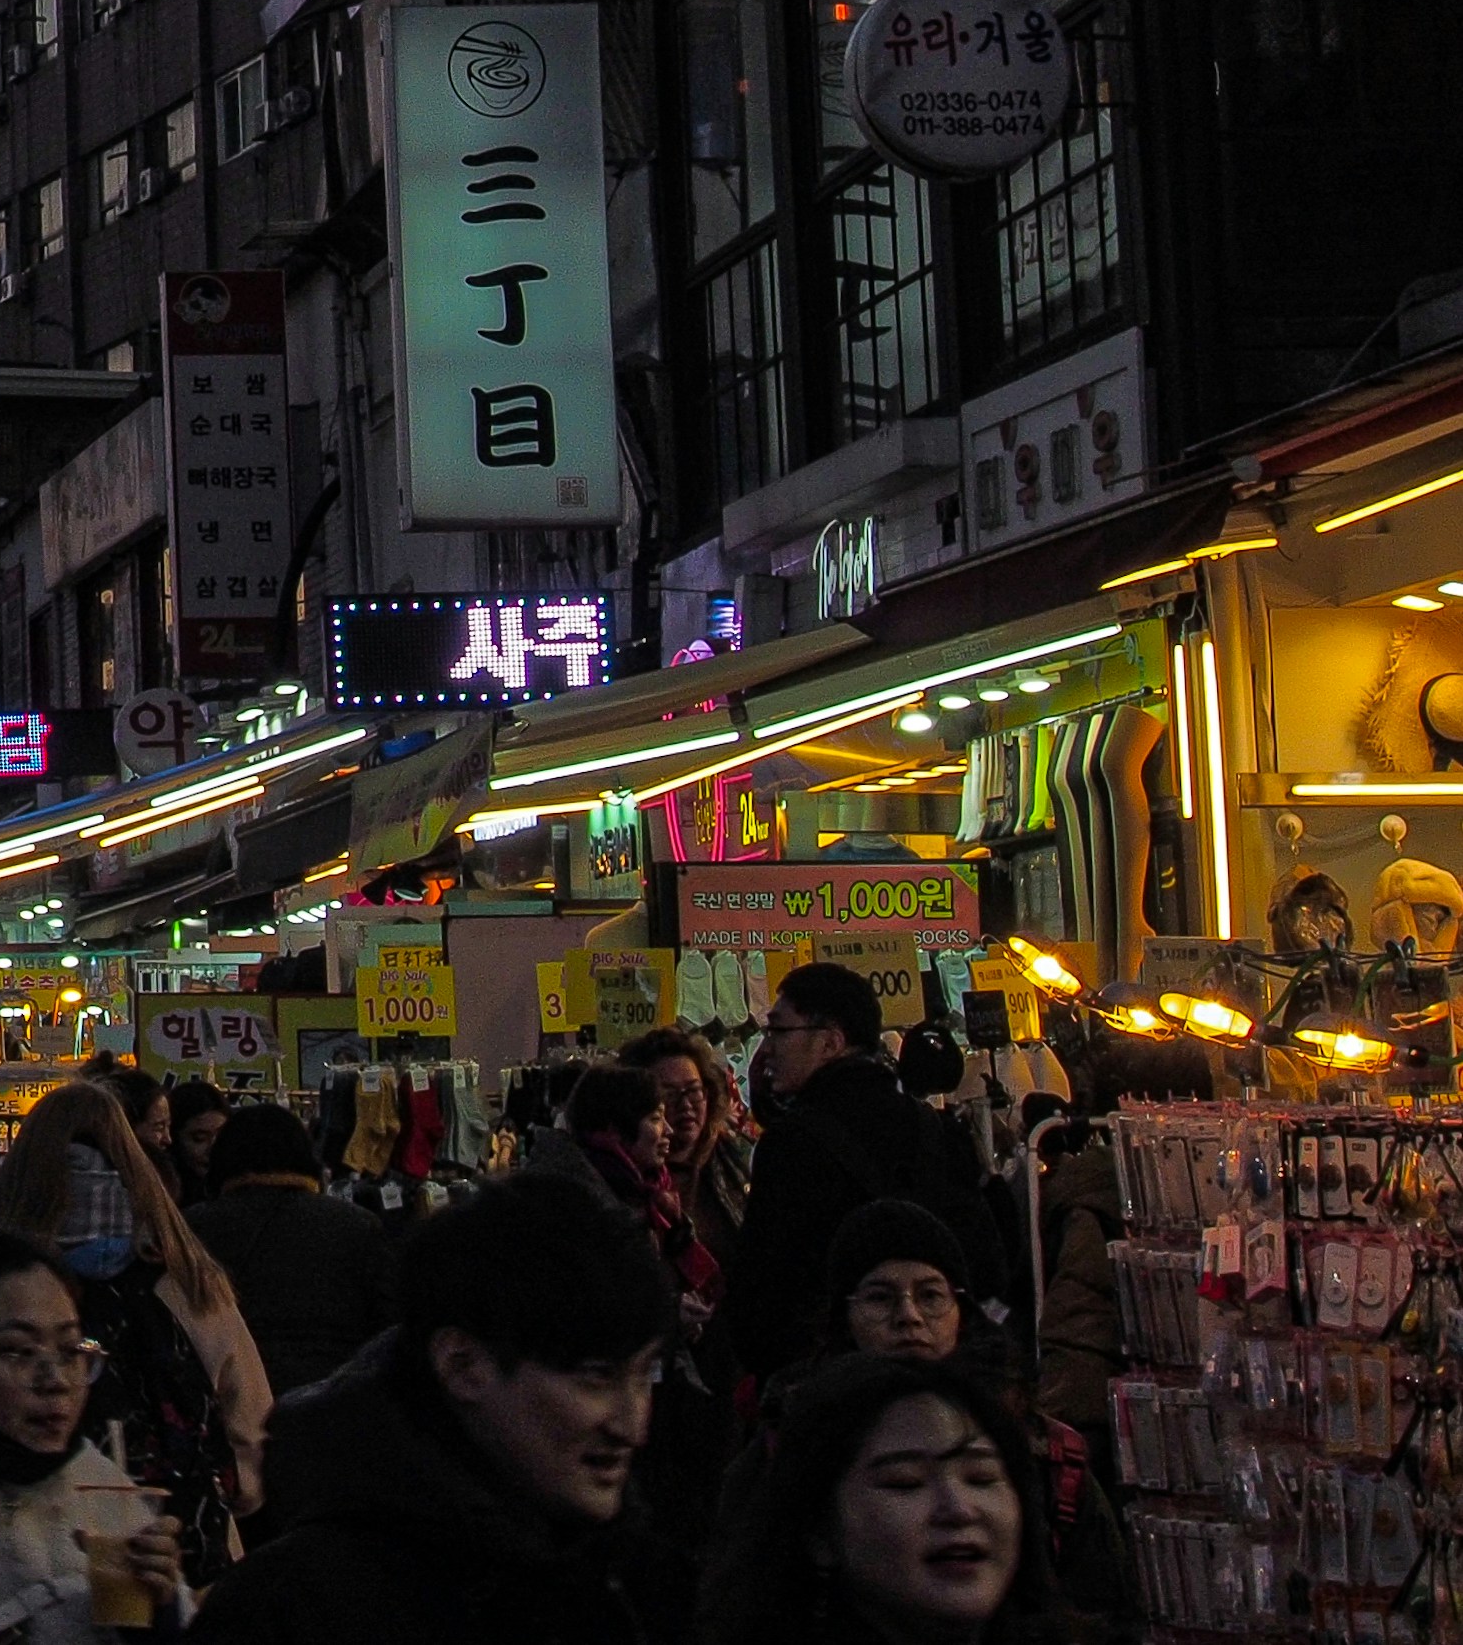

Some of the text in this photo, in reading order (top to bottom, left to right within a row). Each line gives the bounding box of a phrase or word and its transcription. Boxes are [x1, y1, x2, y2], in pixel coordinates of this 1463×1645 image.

[884, 10, 1055, 67] 유리·거울
[900, 92, 1042, 112] 02)336-0474
[460, 145, 558, 468] 三丁目
[191, 376, 268, 396] 보쌈
[189, 415, 274, 436] 순대국
[187, 466, 277, 489] 뼈해장국
[197, 521, 274, 543] 냉면
[196, 576, 279, 599] 삼겹살
[449, 603, 601, 689] 사주
[127, 699, 195, 766] 약
[692, 892, 724, 910] 국산
[726, 892, 742, 910] 면
[744, 892, 775, 910] 양말
[692, 930, 743, 946] MADE
[746, 930, 764, 945] IN
[913, 929, 970, 945] SOCKS
[590, 951, 649, 966] BIG Sale
[379, 969, 430, 982] BIG Sale
[363, 997, 448, 1026] 1,000원
[161, 1015, 258, 1059] 힐링
